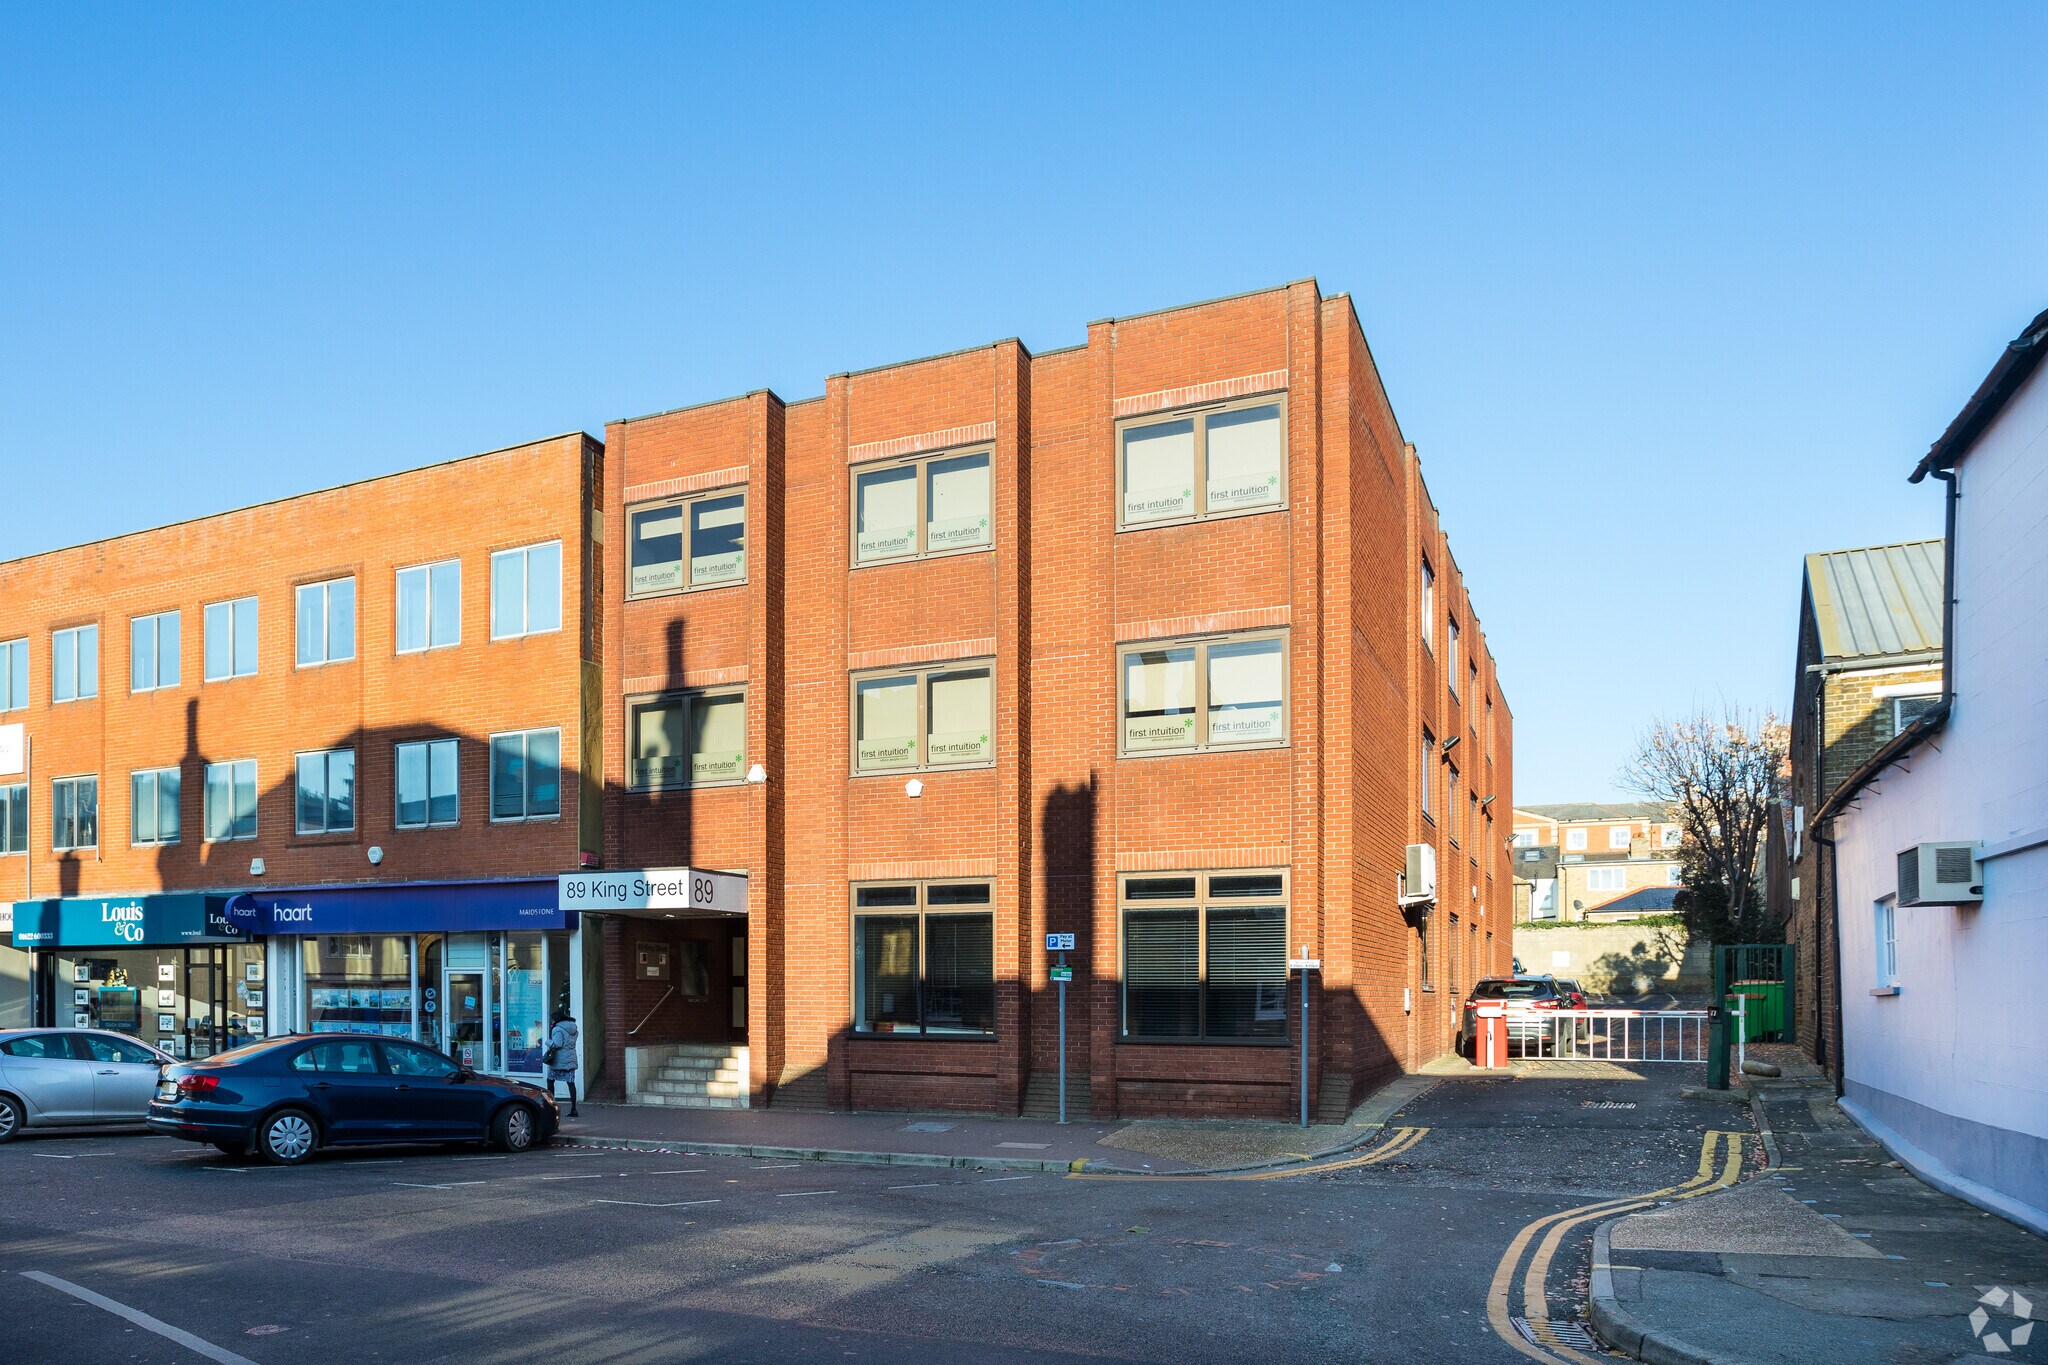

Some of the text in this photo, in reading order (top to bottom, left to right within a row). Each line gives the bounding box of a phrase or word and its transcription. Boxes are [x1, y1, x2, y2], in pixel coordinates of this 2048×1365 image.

[1210, 491, 1228, 500] first
[1231, 484, 1268, 497] intuition
[1128, 497, 1184, 512] first intuition
[930, 532, 946, 540] first
[948, 527, 980, 538] intuition
[861, 537, 908, 550] first intuition
[694, 566, 708, 575] first
[708, 562, 737, 572] intuition
[634, 575, 648, 583] first
[648, 571, 675, 581] intuition
[1212, 719, 1271, 732] first intuition
[1129, 726, 1185, 738] first intuition
[861, 747, 909, 758] first intuition
[931, 741, 981, 753] first intuition
[635, 766, 676, 776] first intuition
[693, 761, 737, 771] first intuition
[566, 878, 684, 902] 89 King Street
[694, 878, 714, 904] 89
[101, 901, 144, 922] Louis
[233, 906, 257, 917] haart
[273, 902, 313, 922] haart
[518, 908, 555, 916] MAIDSTONE
[209, 913, 229, 924] Lou
[114, 921, 145, 942] & Co
[225, 925, 239, 935] Co
[1050, 938, 1056, 946] P
